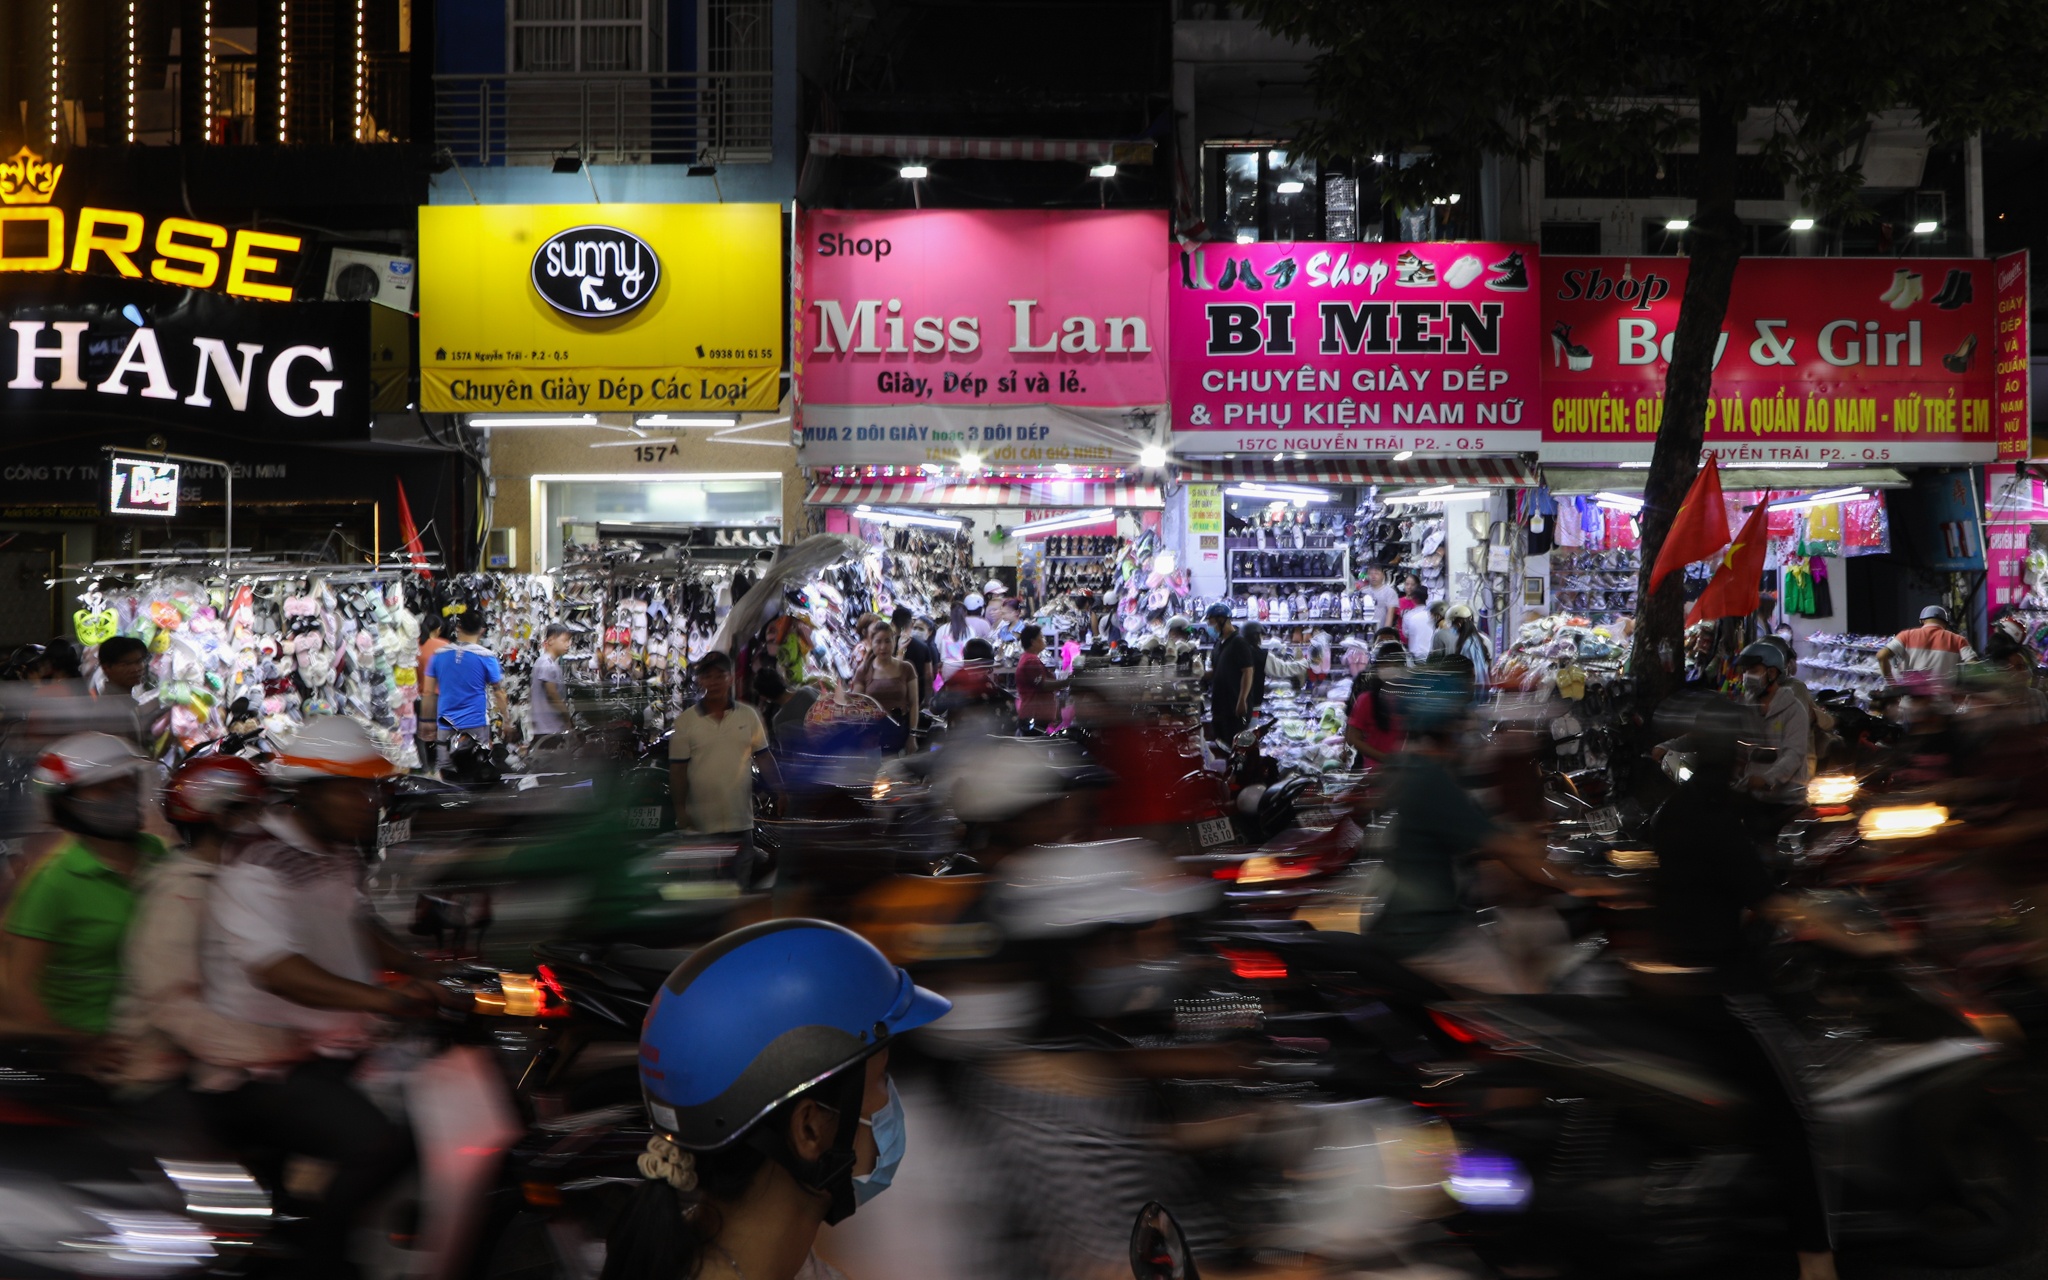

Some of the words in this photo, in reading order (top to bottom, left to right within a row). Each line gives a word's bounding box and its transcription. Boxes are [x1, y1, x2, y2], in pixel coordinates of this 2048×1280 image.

[817, 232, 892, 261] Shop
[546, 240, 645, 300] sunny
[1306, 250, 1390, 295] Shop
[1557, 267, 1670, 311] Shop
[1999, 296, 2022, 314] GIÀY
[813, 298, 980, 354] Miss
[1008, 299, 1152, 354] Lan
[1204, 301, 1296, 356] BI
[1318, 300, 1504, 356] MEN
[2000, 317, 2021, 333] DÉP
[1748, 319, 1796, 367] &
[1816, 318, 1923, 368] Girl
[2004, 337, 2019, 353] VÀ
[7, 303, 343, 418] HÀNG
[452, 351, 471, 361] 157A
[475, 349, 503, 362] Nguyễn
[506, 351, 522, 360] Trãi
[531, 351, 545, 360] P.2
[553, 351, 569, 361] Q.5
[709, 349, 732, 359] 0938
[735, 349, 745, 359] 01
[748, 349, 758, 359] 61
[761, 349, 773, 359] 55
[1997, 355, 2026, 375] QUẦN
[877, 371, 933, 399] Giày,
[943, 371, 988, 397] Dép
[998, 370, 1018, 393] sỉ
[1025, 372, 1050, 393] và
[1059, 370, 1087, 393] lẻ.
[1201, 364, 1340, 393] CHUYÊN
[1351, 364, 1432, 393] GIÀY
[1442, 364, 1509, 392] DÉP
[2004, 378, 2019, 393] ÁO
[450, 376, 533, 405] Chuyên
[540, 376, 590, 406] Giày
[599, 377, 643, 406] Dép
[651, 379, 692, 401] Các
[700, 376, 748, 407] Loại
[1190, 403, 1212, 426] &
[1224, 402, 1292, 430] PHỤ
[1303, 397, 1381, 430] KIỆN
[1392, 402, 1465, 425] NAM
[1475, 399, 1525, 426] NỮ
[1552, 391, 1630, 433] CHUYÊN:
[1635, 391, 1664, 433] GIÀ
[1721, 391, 1745, 433] VÀ
[1749, 387, 1800, 437] QUẦN
[1805, 390, 1829, 433] ÁO
[1834, 398, 1876, 433] NAM
[1894, 392, 1922, 433] NỮ
[1924, 388, 1956, 433] TRẺ
[1961, 399, 1989, 433] EM
[2000, 400, 2024, 414] NAM
[803, 426, 838, 441] MUA
[842, 426, 852, 441] 2
[856, 424, 885, 441] ĐÔI
[889, 423, 928, 441] GIÀY
[967, 427, 978, 441] 3
[983, 425, 1012, 441] ĐÔI
[1017, 424, 1050, 441] DÉP
[2004, 416, 2021, 432] NỮ
[1236, 438, 1278, 450] 157C
[1283, 433, 1357, 451] NGUYỄN
[1363, 436, 1405, 450] TRÃI
[1415, 438, 1440, 450] P2.
[1456, 437, 1485, 450] Q.5
[1997, 436, 2014, 453] TRẺ
[2016, 439, 2027, 453] EM
[1021, 444, 1043, 460] CÁI
[1701, 443, 1763, 460] GUYỄN
[1768, 445, 1810, 460] TRÃI
[1819, 448, 1845, 460] P2.
[1861, 447, 1890, 460] Q.5
[4, 462, 49, 481] CÔNG
[52, 466, 75, 480] TY
[1201, 820, 1227, 834] 59-N3
[1202, 831, 1232, 845] 565.10
